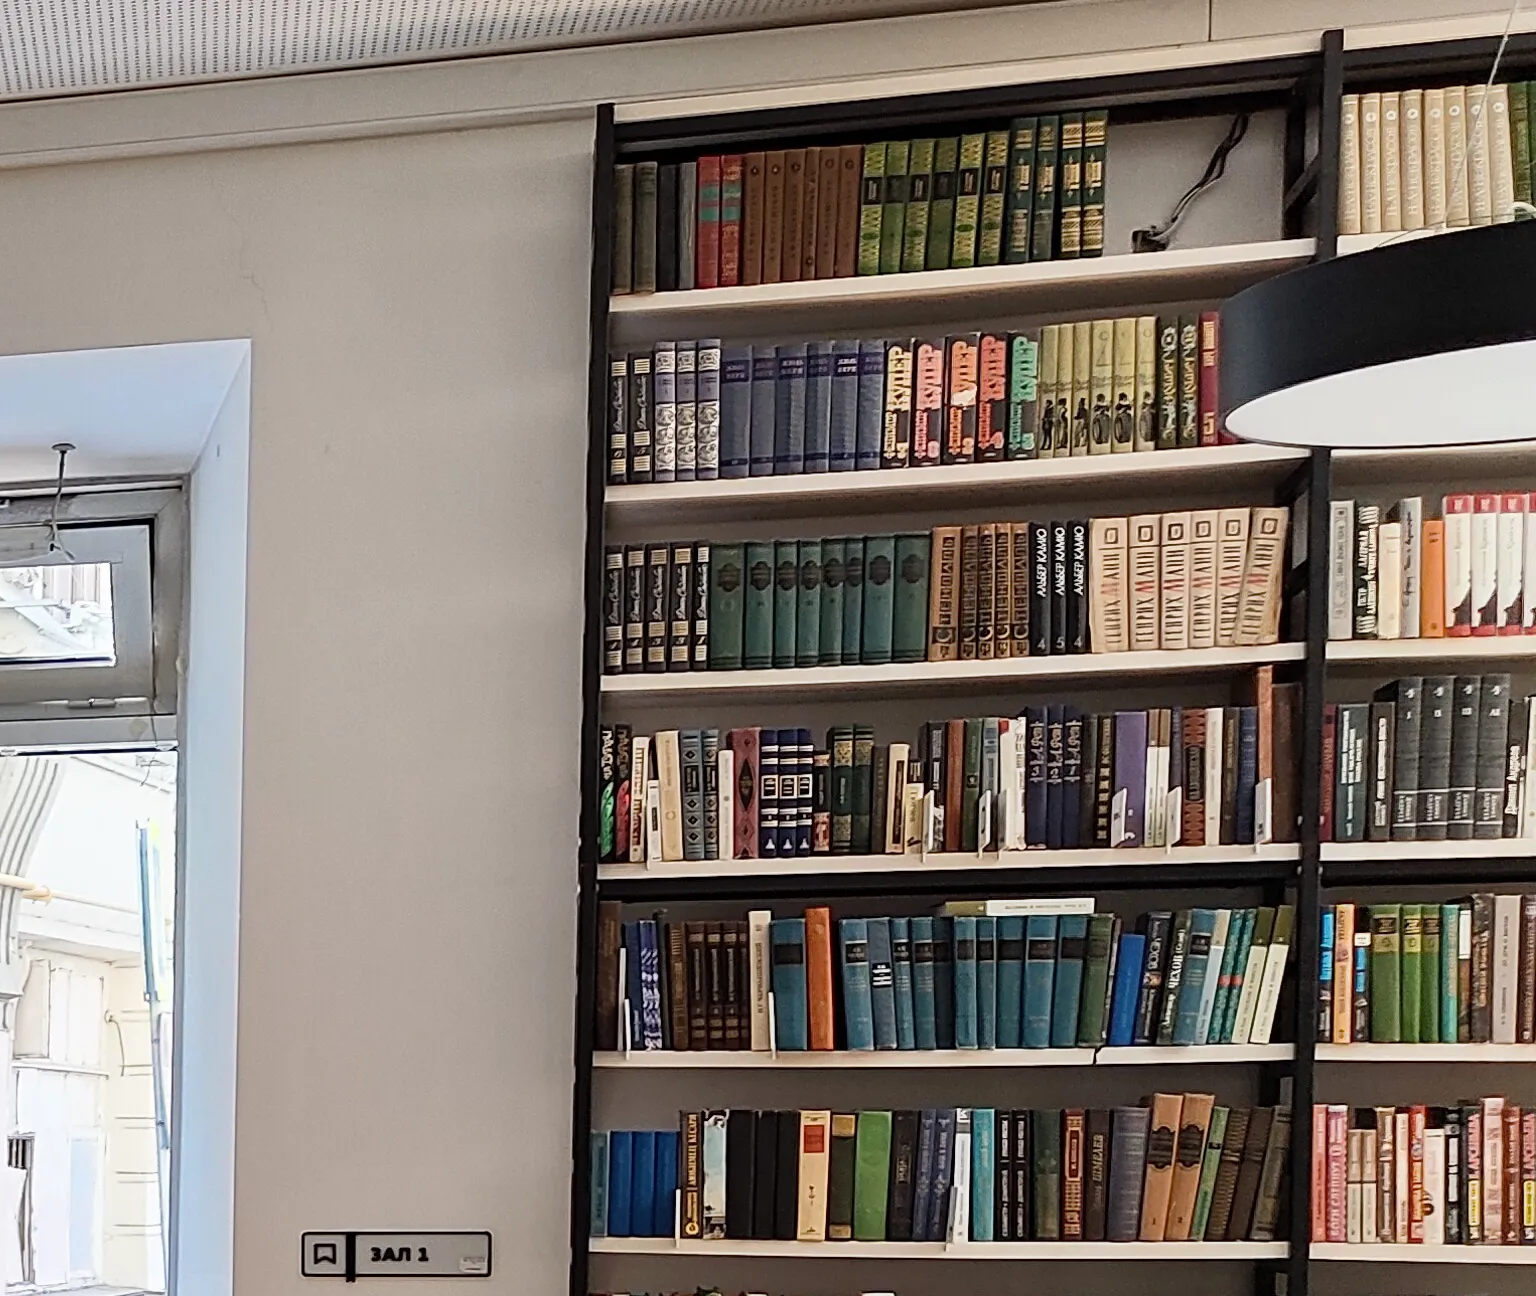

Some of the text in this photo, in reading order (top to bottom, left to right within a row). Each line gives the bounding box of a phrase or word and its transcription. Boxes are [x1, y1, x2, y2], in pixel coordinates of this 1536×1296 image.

[1037, 638, 1046, 649] 4
[1056, 637, 1065, 649] 5
[1074, 637, 1082, 648] 4
[370, 1247, 429, 1262] ЗАЛ 1
